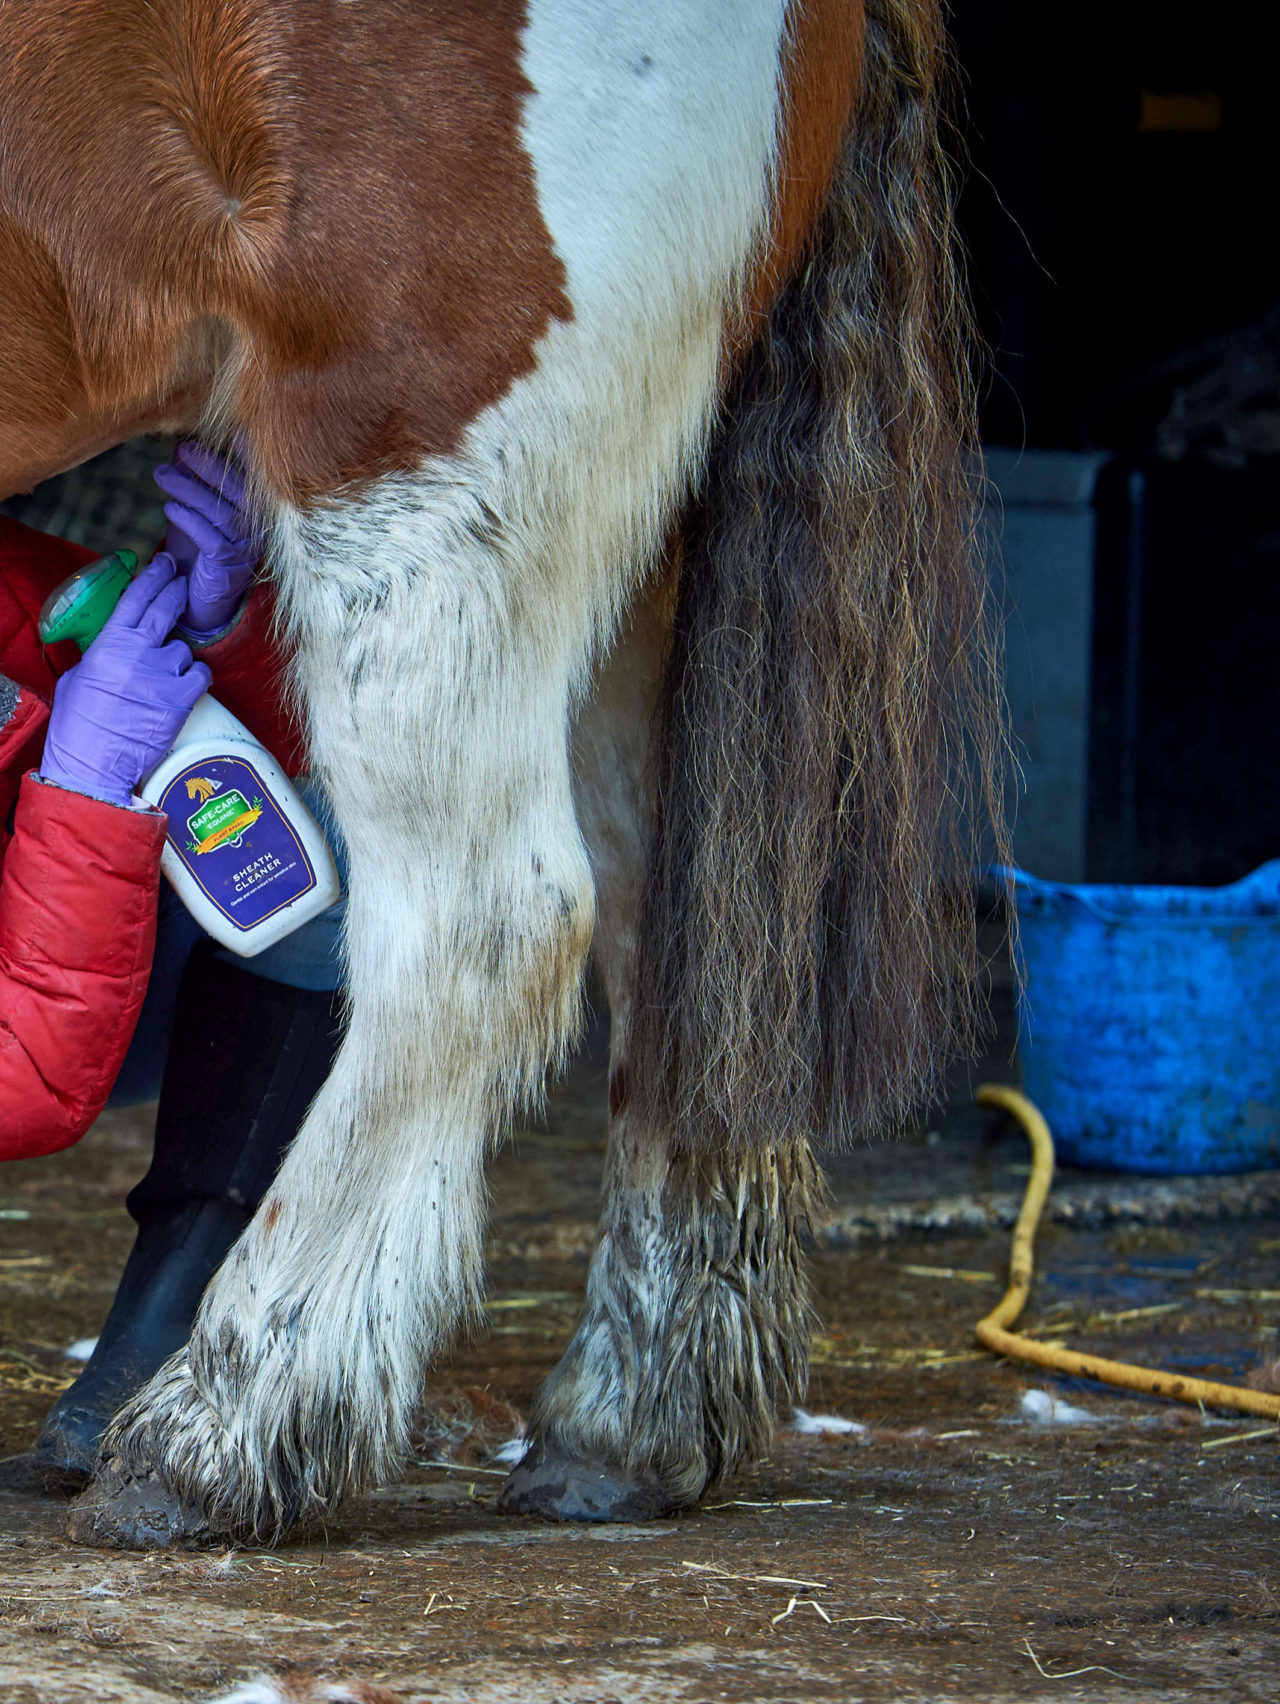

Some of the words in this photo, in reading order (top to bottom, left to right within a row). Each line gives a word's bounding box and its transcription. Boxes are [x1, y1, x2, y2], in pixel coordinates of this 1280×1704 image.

[191, 793, 241, 830] SAFE-CARE
[232, 851, 273, 882] SHEATH
[235, 858, 282, 892] CLEANER
